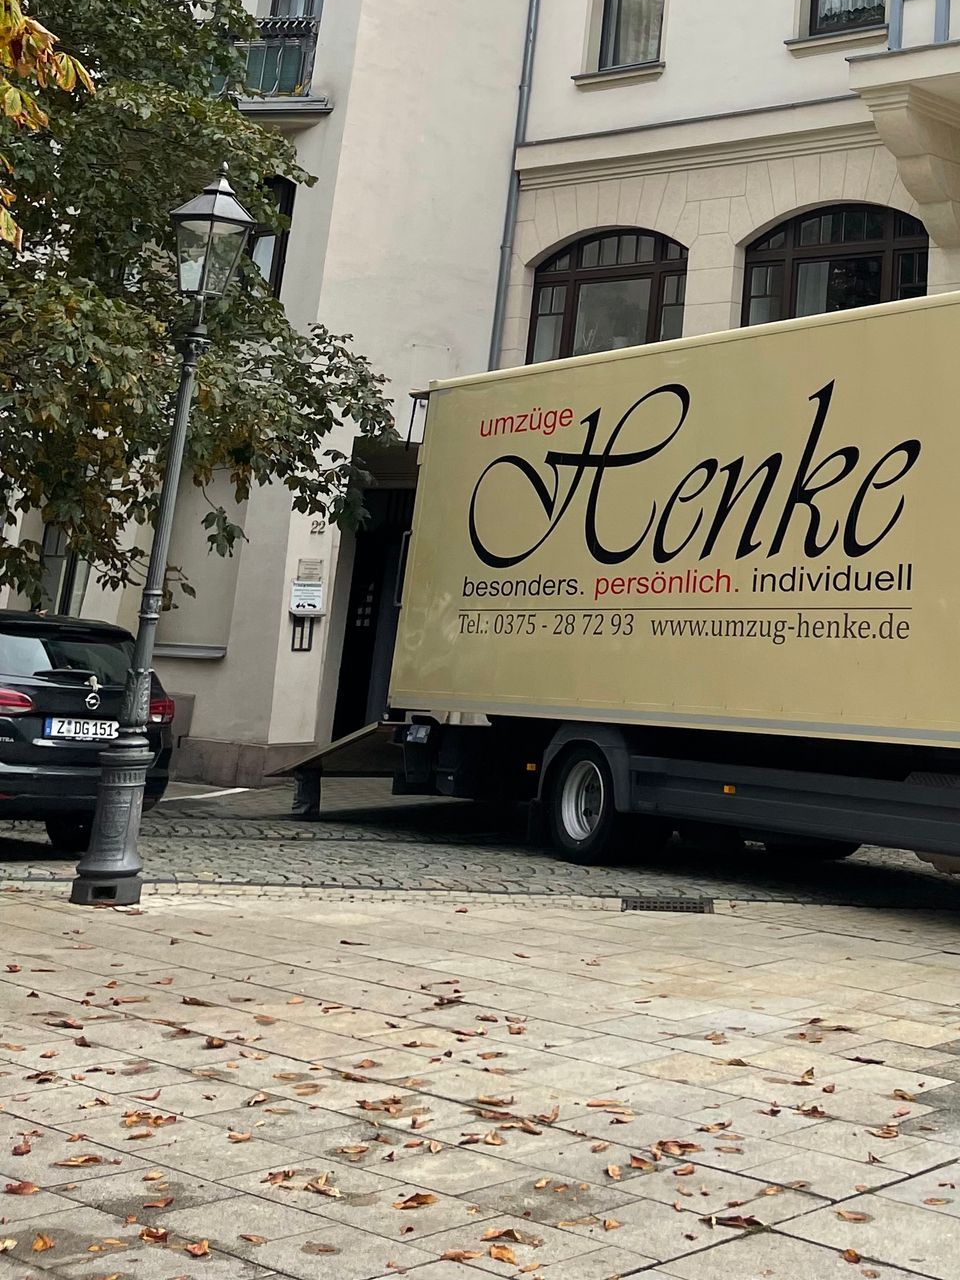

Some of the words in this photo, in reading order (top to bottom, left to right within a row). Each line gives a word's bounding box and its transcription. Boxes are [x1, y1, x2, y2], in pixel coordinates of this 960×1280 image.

[480, 407, 574, 437] umzüge
[469, 379, 921, 568] Henke
[310, 520, 326, 535] 22
[462, 574, 585, 597] besonders.
[594, 568, 739, 601] persönlich.
[752, 563, 912, 592] individuell
[458, 613, 489, 635] Tel.:
[494, 613, 537, 635] 0375
[553, 613, 576, 636] 28
[582, 613, 605, 636] 72
[611, 613, 635, 636] 93
[651, 612, 910, 645] www.umzug-henke.de
[57, 720, 65, 734] Z
[92, 722, 113, 736] 151
